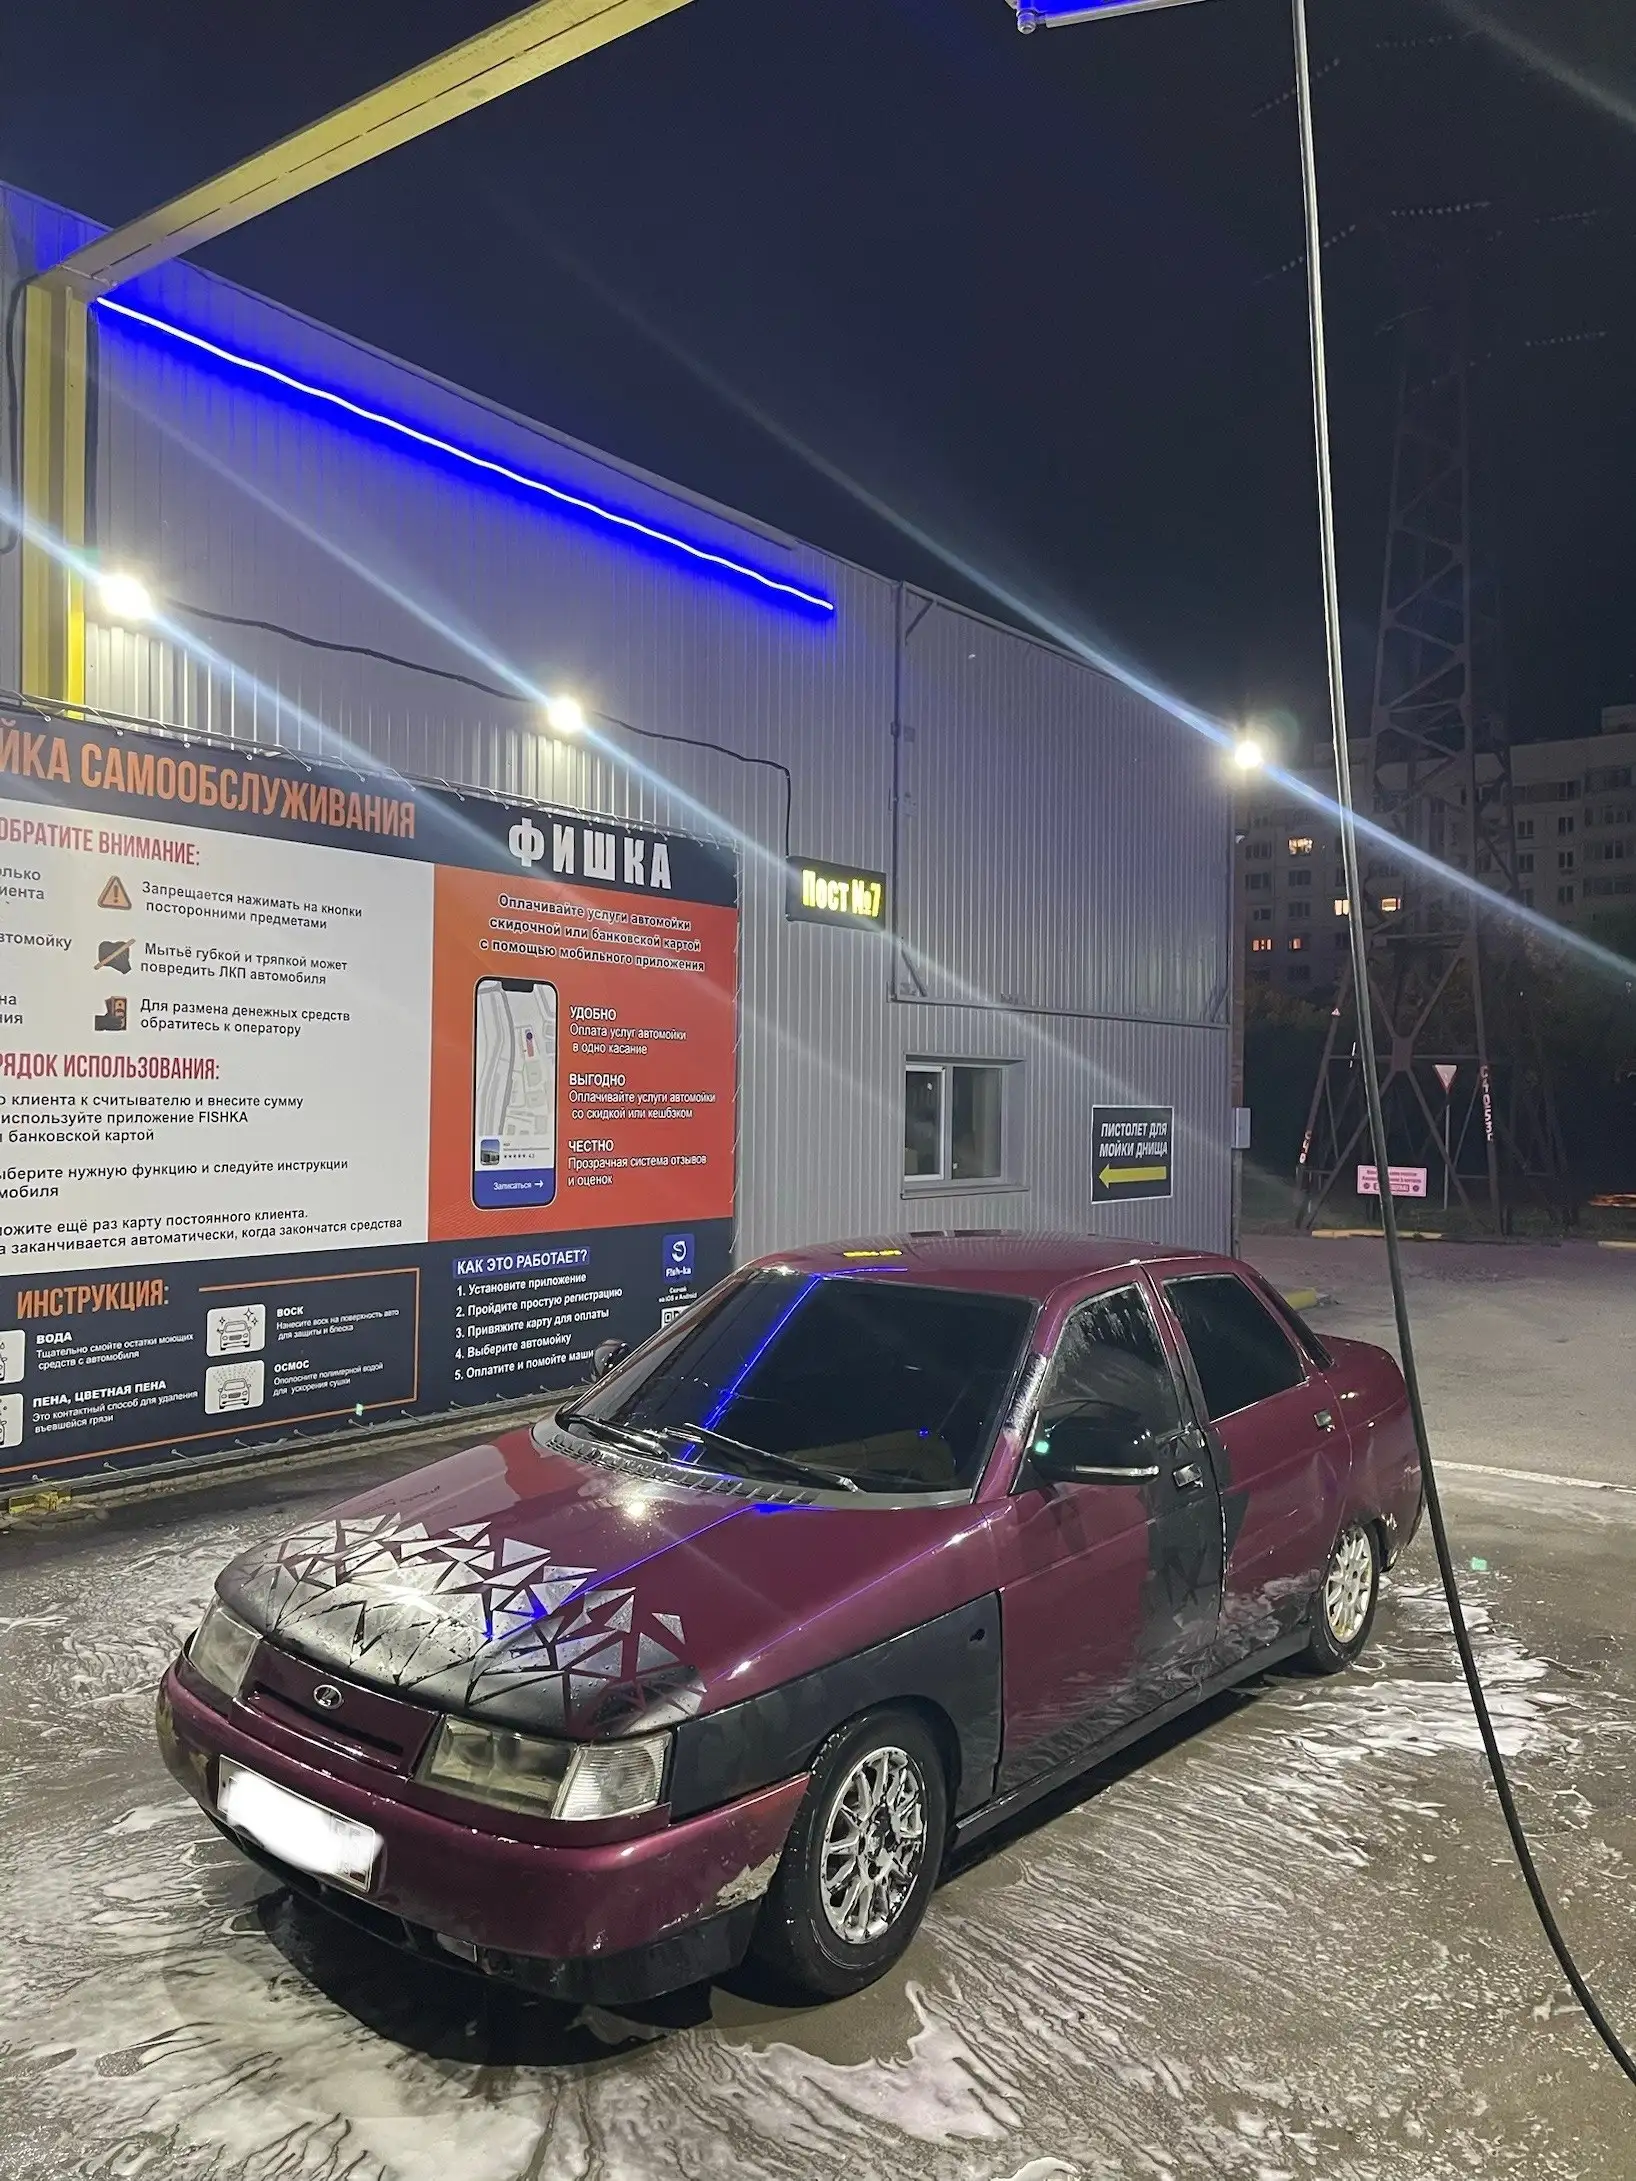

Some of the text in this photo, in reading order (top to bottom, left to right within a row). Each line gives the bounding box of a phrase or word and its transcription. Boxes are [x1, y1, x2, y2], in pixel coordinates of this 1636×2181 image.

[0, 717, 416, 840] ЙКА САМООБСЛУЖИВАНИЯ
[0, 816, 201, 866] ОБРАТИТЕ ВНИМАНИЕ:
[508, 818, 672, 890] ФИШКА
[142, 881, 363, 918] Запрещается нажимать на кнопки
[802, 869, 881, 917] Пост №7
[145, 901, 328, 931] посторонними предметами
[498, 894, 691, 930] Оплачивайте услуги автомойки
[489, 917, 701, 952] скидочной или банковской картой
[144, 942, 348, 972] Мытьё губкой и тряпкой может
[480, 940, 705, 972] с помощью мобильного приложения
[140, 962, 326, 985] повредить ЛКП автомобиля
[140, 999, 350, 1025] Для размена денежных средств
[569, 1006, 617, 1020] УДОБНО
[140, 1017, 301, 1038] обратитесь к оператору
[570, 1024, 687, 1041] Оплата услуг автомойки
[573, 1044, 648, 1056] в одно касание
[63, 1054, 220, 1081] ИСПОЛЬЗОВАНИЯ:
[569, 1074, 626, 1087] ВЫГОДНО
[11, 1095, 76, 1107] клиента
[80, 1095, 89, 1107] к
[92, 1095, 191, 1107] считывателю
[194, 1096, 203, 1107] и
[207, 1096, 260, 1108] внесите
[263, 1096, 304, 1110] сумму
[569, 1090, 716, 1105] Оплачивайте услуги автомойки
[1, 1108, 248, 1127] используйте приложение FISHKA
[572, 1107, 693, 1121] со скидкой или кешбэком
[8, 1128, 100, 1143] банковской
[105, 1128, 154, 1144] картой
[1101, 1122, 1168, 1139] ПИСТОЛЕТ ДЛЯ
[569, 1140, 614, 1152] ЧЕСТНО
[1099, 1140, 1168, 1159] МОЙКИ ДНИЩА
[68, 1158, 348, 1181] нужную функцию и следуйте инструкции
[568, 1156, 707, 1171] Прозрачная система отзывов
[493, 1182, 532, 1191] Записаться
[568, 1175, 613, 1187] и оценок
[57, 1208, 308, 1236] ещё раз карту постоянного клиента.
[11, 1234, 126, 1255] заканчивается
[130, 1228, 238, 1247] автоматически,
[242, 1226, 276, 1240] когда
[279, 1221, 346, 1237] закончатся
[350, 1217, 403, 1233] средства
[457, 1249, 588, 1275] КАК ЭТО РАБОТАЕТ?
[457, 1273, 587, 1298] 1. Установите приложение
[17, 1278, 169, 1320] ИНСТРУКЦИЯ:
[456, 1287, 623, 1318] 2. Пройдите простую регистрацию
[276, 1309, 400, 1331] Нанесите воск поверхность авто
[277, 1306, 304, 1317] ВОСК
[277, 1324, 354, 1341] для защиты блеска
[456, 1308, 610, 1339] 3. Привяжите карту для оплаты
[36, 1331, 73, 1346] ВОДА
[36, 1332, 194, 1359] Тщательно смойте остатки моющих
[455, 1333, 572, 1360] 4. Выберите автомойку
[38, 1350, 140, 1372] средств автомобиля
[274, 1359, 309, 1372] ОСМОС
[455, 1353, 566, 1381] 5. Оплатите и помойте
[273, 1361, 383, 1387] Ополосните полимерной водой
[33, 1380, 167, 1409] ПЕНА, ЦВЕТНАЯ ПЕНА
[273, 1378, 351, 1397] для ускорения сушки
[32, 1390, 198, 1423] Это контактный способ для удаления
[35, 1414, 114, 1434] въевшейся грязи
